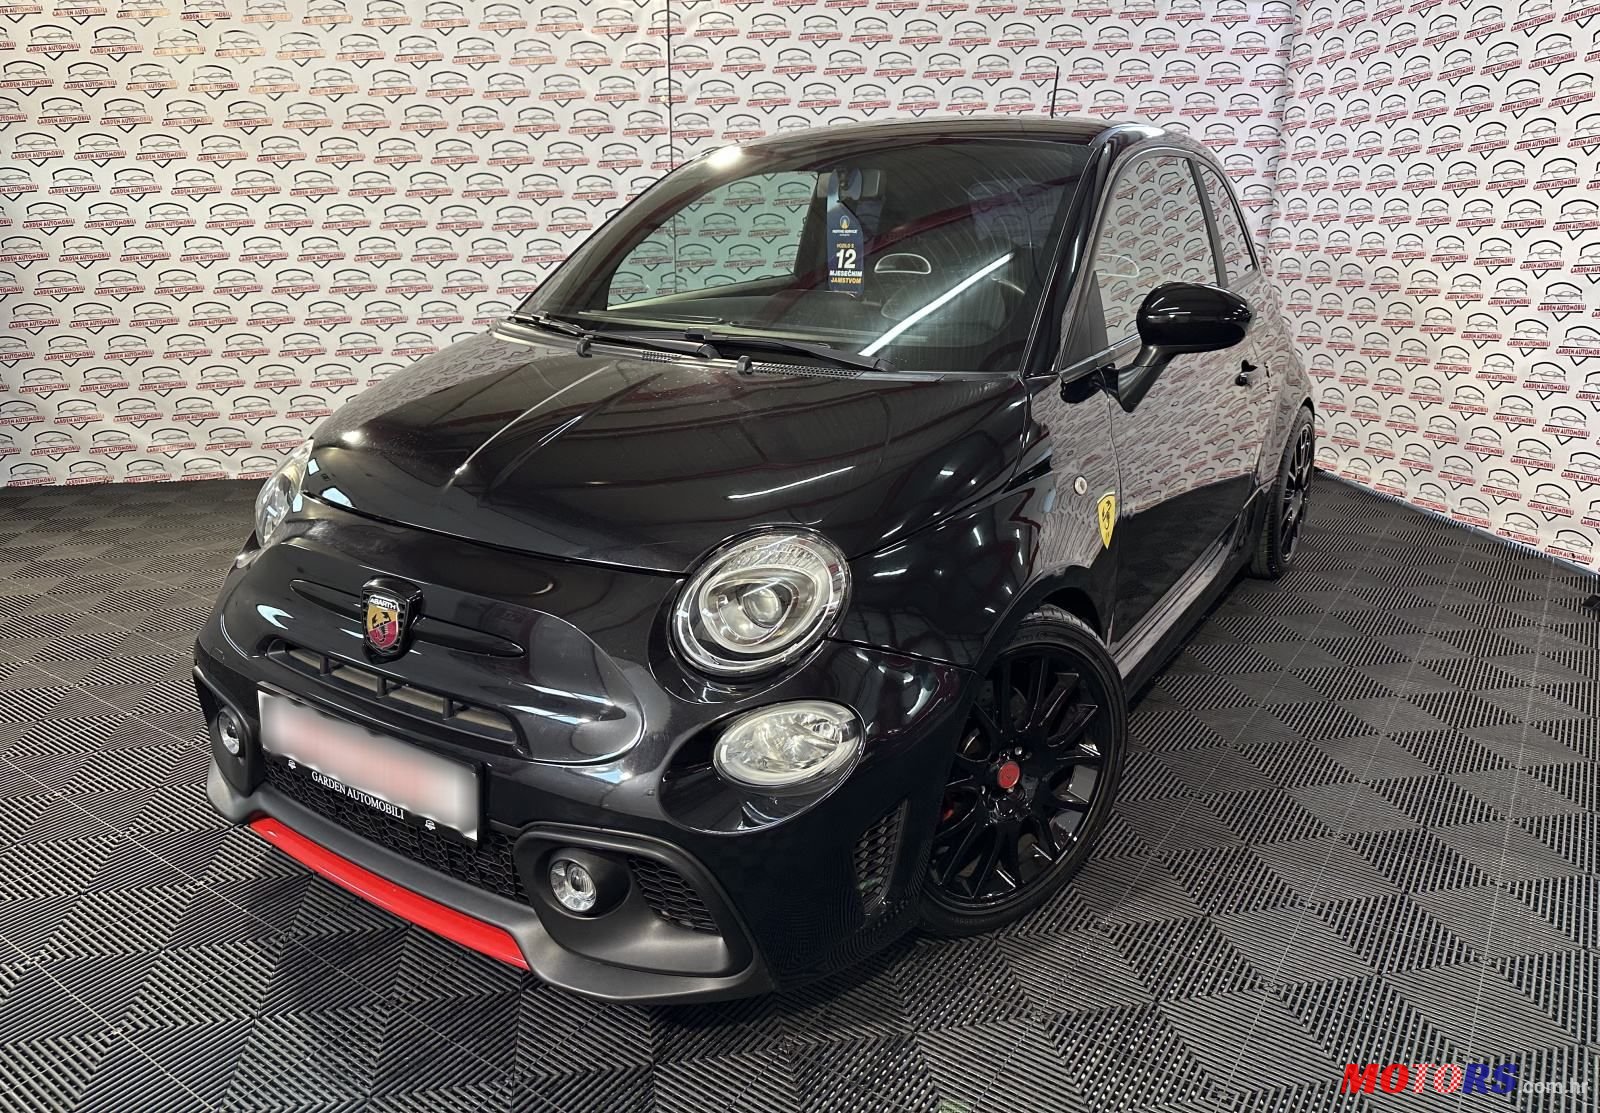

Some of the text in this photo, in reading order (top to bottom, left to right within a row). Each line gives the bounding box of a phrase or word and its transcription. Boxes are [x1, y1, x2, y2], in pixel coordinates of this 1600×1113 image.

[1561, 13, 1580, 23] GARDEN
[1528, 51, 1577, 70] GARDEN AUTOMOBILI
[1548, 91, 1596, 109] GARDEN AUTOMOBILI
[1514, 136, 1560, 151] GARDEN AUTOMOBILI
[1567, 140, 1586, 148] GARDEN
[1533, 177, 1580, 191] GARDEN AUTOMOBILI
[1552, 223, 1571, 231] GARDEN
[836, 249, 857, 268] 12
[1541, 426, 1590, 437] GARDEN AUTOMOBILI
[1527, 502, 1574, 515] GARDEN AUTOMOBILI
[1581, 519, 1600, 527] GARDEN
[1544, 547, 1563, 556] GARDEN
[370, 598, 396, 610] ABARTH
[311, 771, 404, 820] GARDEN AUTOMOBILI
